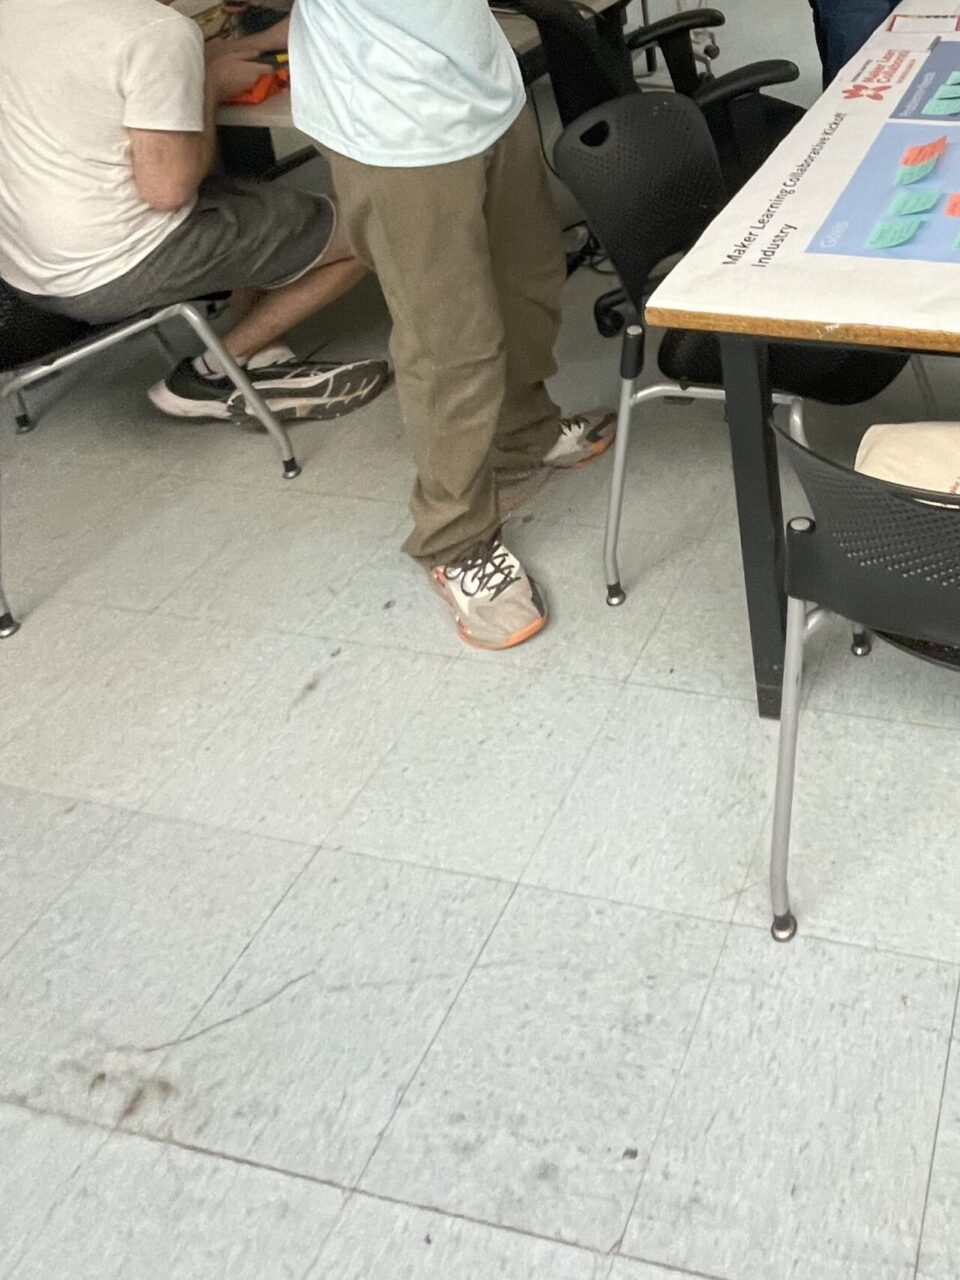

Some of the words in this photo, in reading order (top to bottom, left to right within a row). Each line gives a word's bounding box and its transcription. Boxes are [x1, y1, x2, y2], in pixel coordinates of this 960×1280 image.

[722, 228, 759, 265] Maker
[750, 185, 796, 230] Learning
[782, 132, 830, 188] Collaborative
[751, 223, 798, 268] Industry
